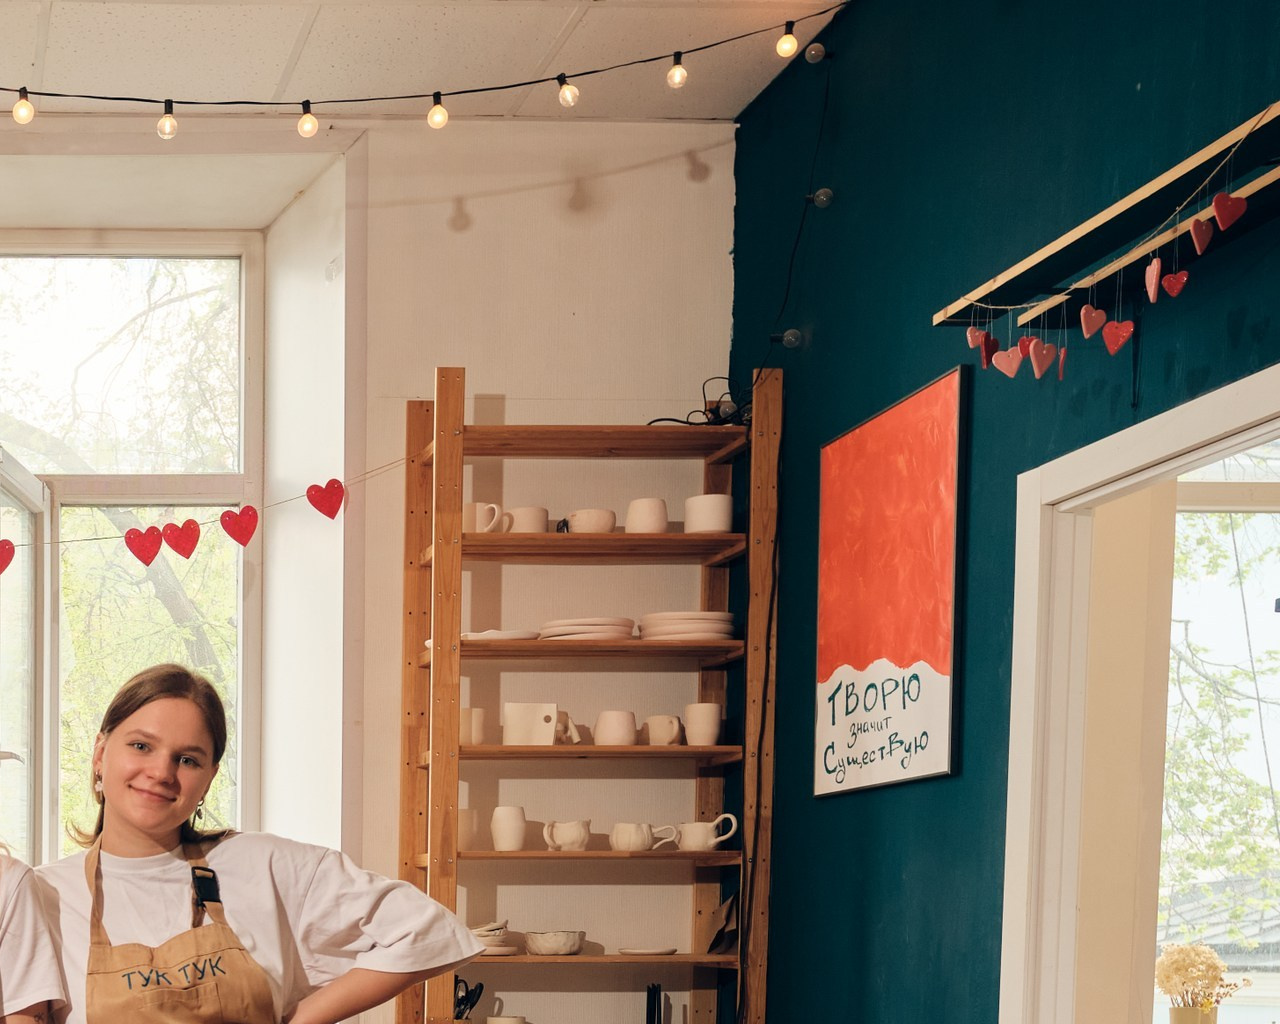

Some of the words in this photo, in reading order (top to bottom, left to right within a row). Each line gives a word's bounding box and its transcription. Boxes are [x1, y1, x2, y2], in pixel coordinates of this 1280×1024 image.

[828, 673, 921, 726] ТВОРЮ
[847, 716, 892, 748] значит
[121, 969, 172, 990] ТУК
[178, 956, 226, 984] ТУК
